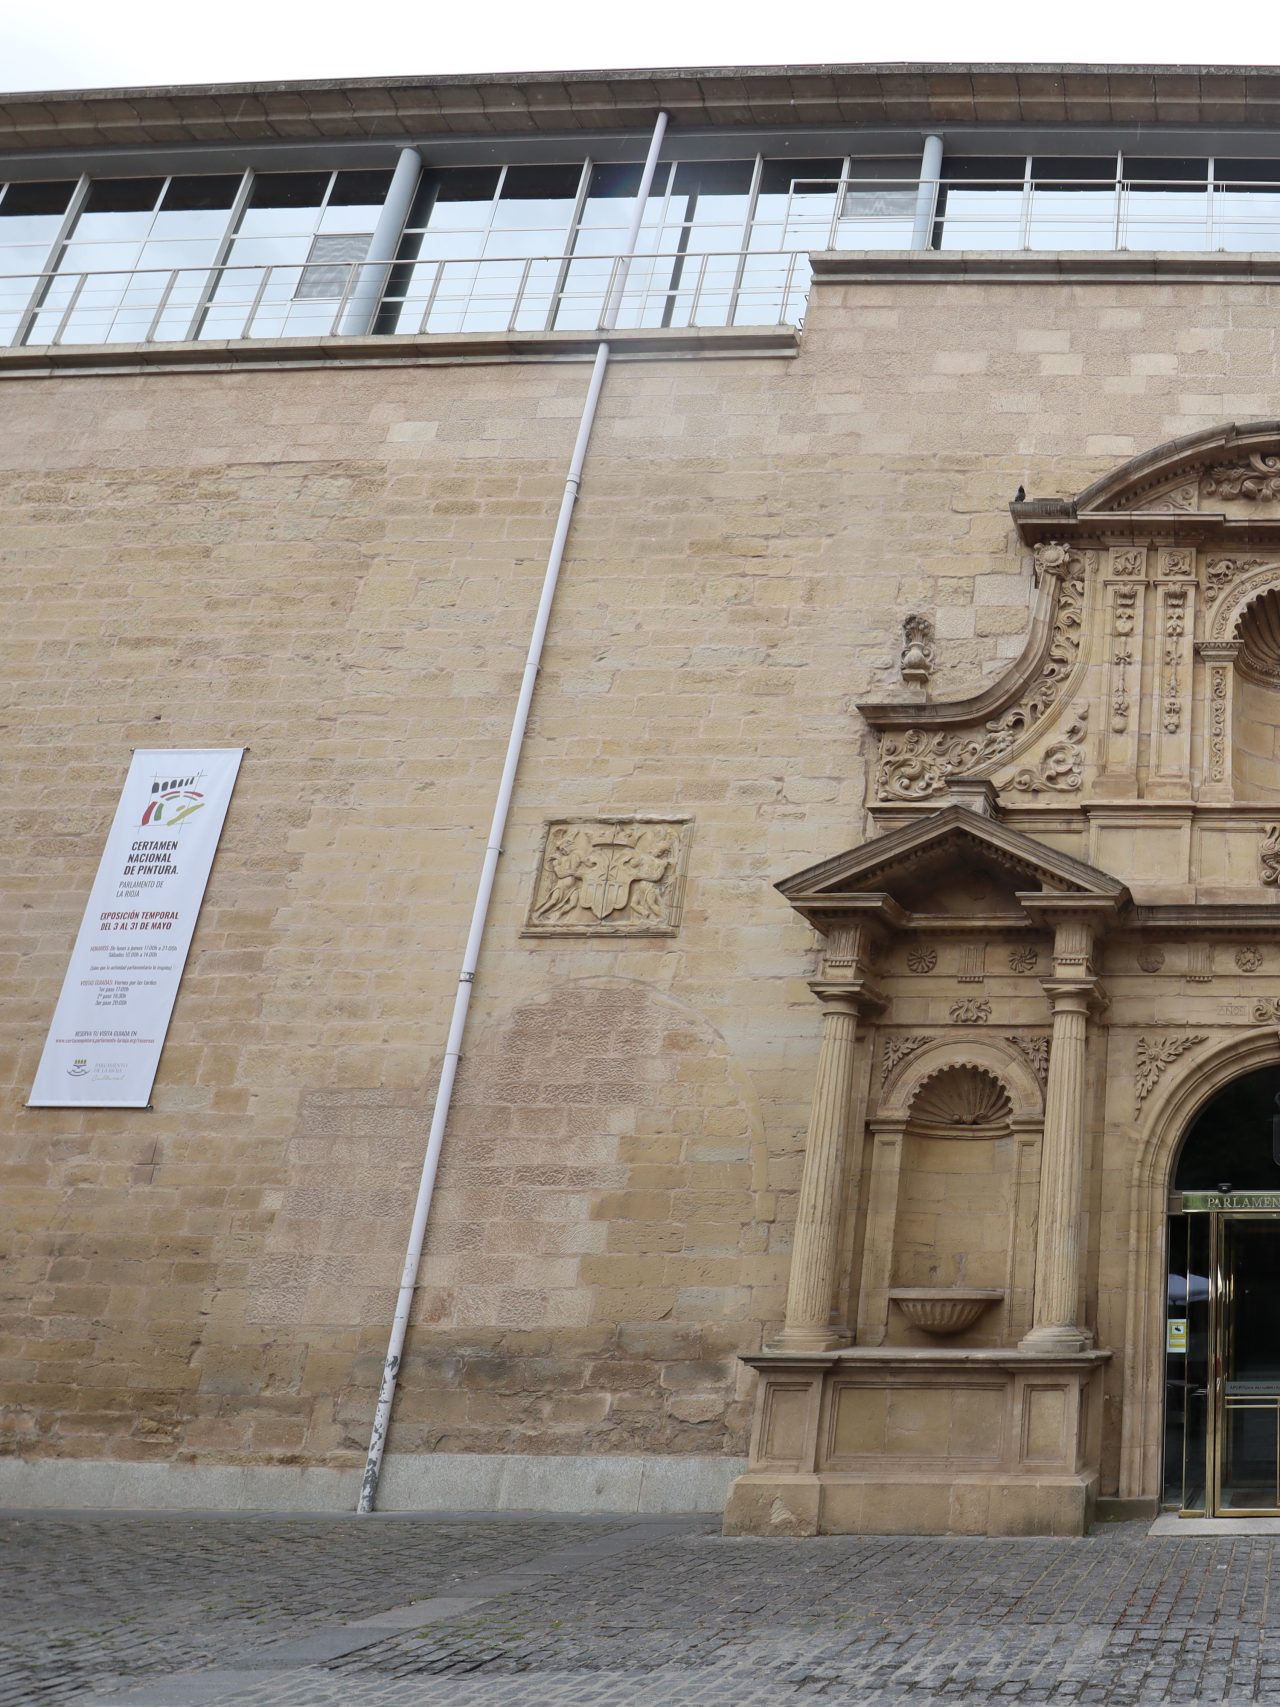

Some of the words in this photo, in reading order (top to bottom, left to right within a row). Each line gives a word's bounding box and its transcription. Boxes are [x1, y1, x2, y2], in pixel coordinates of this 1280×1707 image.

[131, 841, 178, 851] CERTAMEN
[127, 852, 172, 863] NACIONAL
[123, 865, 137, 876] DE
[137, 864, 179, 875] PINTURA.
[118, 880, 155, 889] PARLAMENTO
[115, 889, 124, 898] LA
[124, 889, 140, 898] RIOJA
[100, 910, 139, 920] EXPOSICIÓN
[141, 911, 179, 920] TEMPORAL
[100, 922, 112, 931] DEL
[113, 922, 119, 931] 3
[119, 922, 129, 931] AL
[130, 922, 138, 931] 31
[139, 922, 149, 931] DE
[150, 921, 173, 931] MAYO
